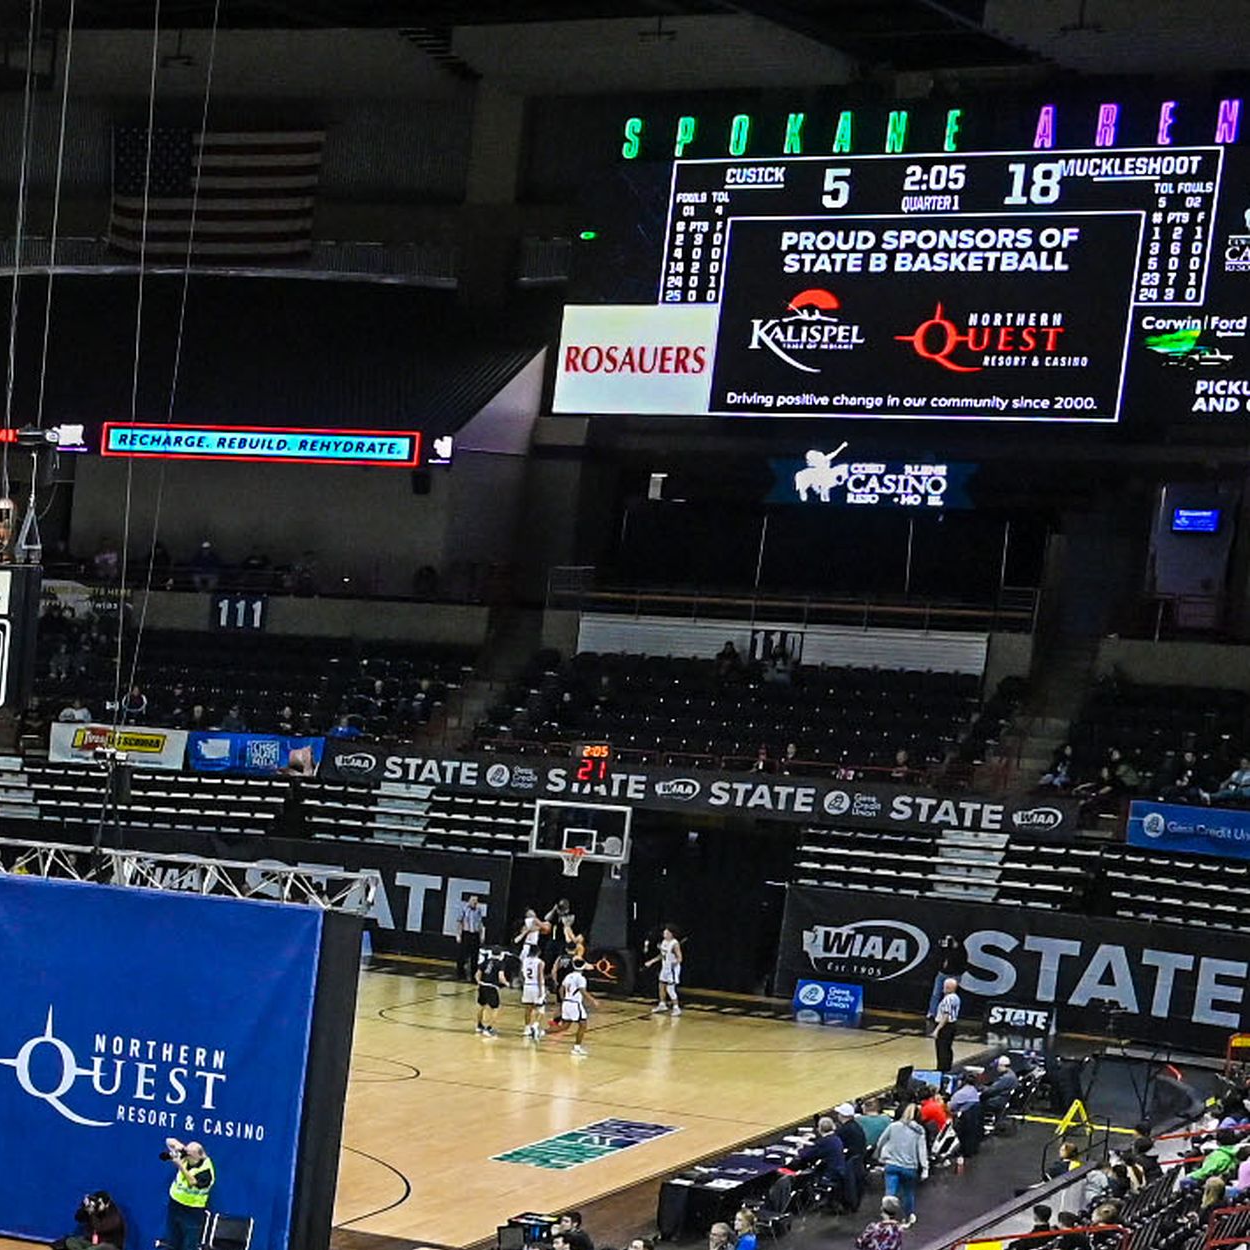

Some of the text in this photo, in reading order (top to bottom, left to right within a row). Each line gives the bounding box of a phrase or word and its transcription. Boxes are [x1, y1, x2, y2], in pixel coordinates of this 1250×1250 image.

[622, 109, 960, 158] SPOKANE
[725, 167, 786, 183] CUSICK
[903, 165, 966, 192] 2:05
[1059, 156, 1203, 177] MUCKLESHOOT
[821, 168, 851, 209] 5
[1004, 162, 1061, 205] 18
[1177, 182, 1214, 194] FOULS
[781, 228, 1079, 251] PROUD SPONSORS OF
[1172, 227, 1183, 240] 2
[783, 251, 1069, 273] STATE B BASKETBALL
[1140, 272, 1160, 286] 23
[968, 313, 1063, 327] NORTHERN
[1142, 316, 1248, 330] Corwin Ford
[748, 319, 866, 364] KALISPEL
[895, 302, 1065, 372] QUEST
[564, 345, 707, 375] ROSAUERS
[982, 356, 1028, 368] RESORT
[1045, 357, 1089, 368] CASINO
[727, 392, 1098, 410] Driving positive change in our community since 2000.
[1192, 398, 1239, 412] AND
[117, 433, 402, 456] RECHARGE. REBUILD. REHYDRATE.
[847, 474, 948, 495] CASINO
[218, 598, 263, 628] 111
[583, 745, 610, 758] 2:05
[383, 756, 479, 785] STATE
[577, 758, 607, 781] 21
[707, 781, 817, 813] STATE
[889, 795, 1005, 830] STATE
[823, 931, 908, 963] WIAA
[957, 930, 1249, 1029] STATE
[989, 1005, 1049, 1031] STATE
[94, 1033, 226, 1070] NORTHERN
[116, 1104, 265, 1142] RESORT & CASINO
